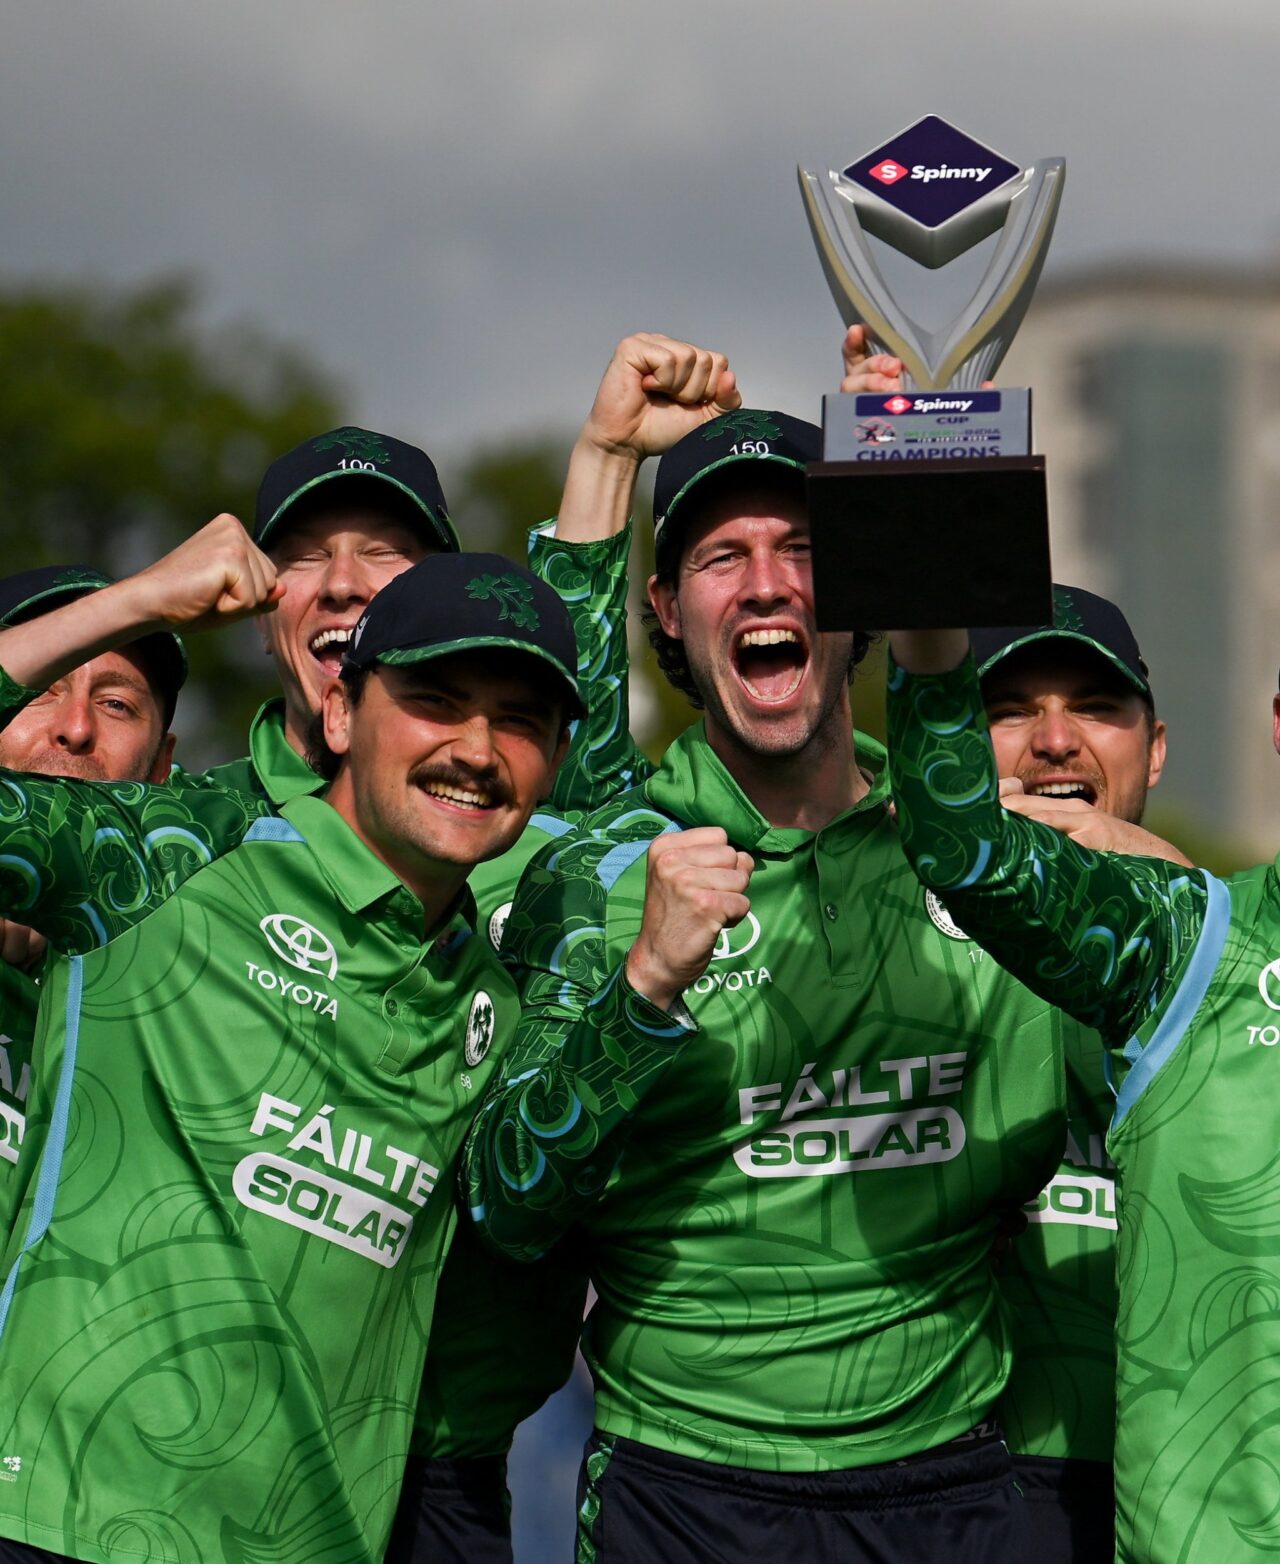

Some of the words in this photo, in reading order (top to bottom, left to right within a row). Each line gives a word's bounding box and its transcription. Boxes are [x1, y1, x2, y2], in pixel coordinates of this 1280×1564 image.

[881, 165, 898, 179] S
[911, 164, 993, 183] Spinny
[913, 398, 973, 413] Spinny
[936, 416, 969, 425] CUP
[729, 441, 770, 456] 150
[856, 446, 1000, 461] CHAMPIONS
[245, 961, 338, 1022] TOYOTA
[682, 966, 772, 994] OYOTA
[460, 1073, 472, 1089] 58
[738, 1051, 967, 1125] FÁILTE
[249, 1092, 439, 1207] FÁILTE
[750, 1117, 952, 1166] SOLAR
[248, 1164, 407, 1258] SOLAR
